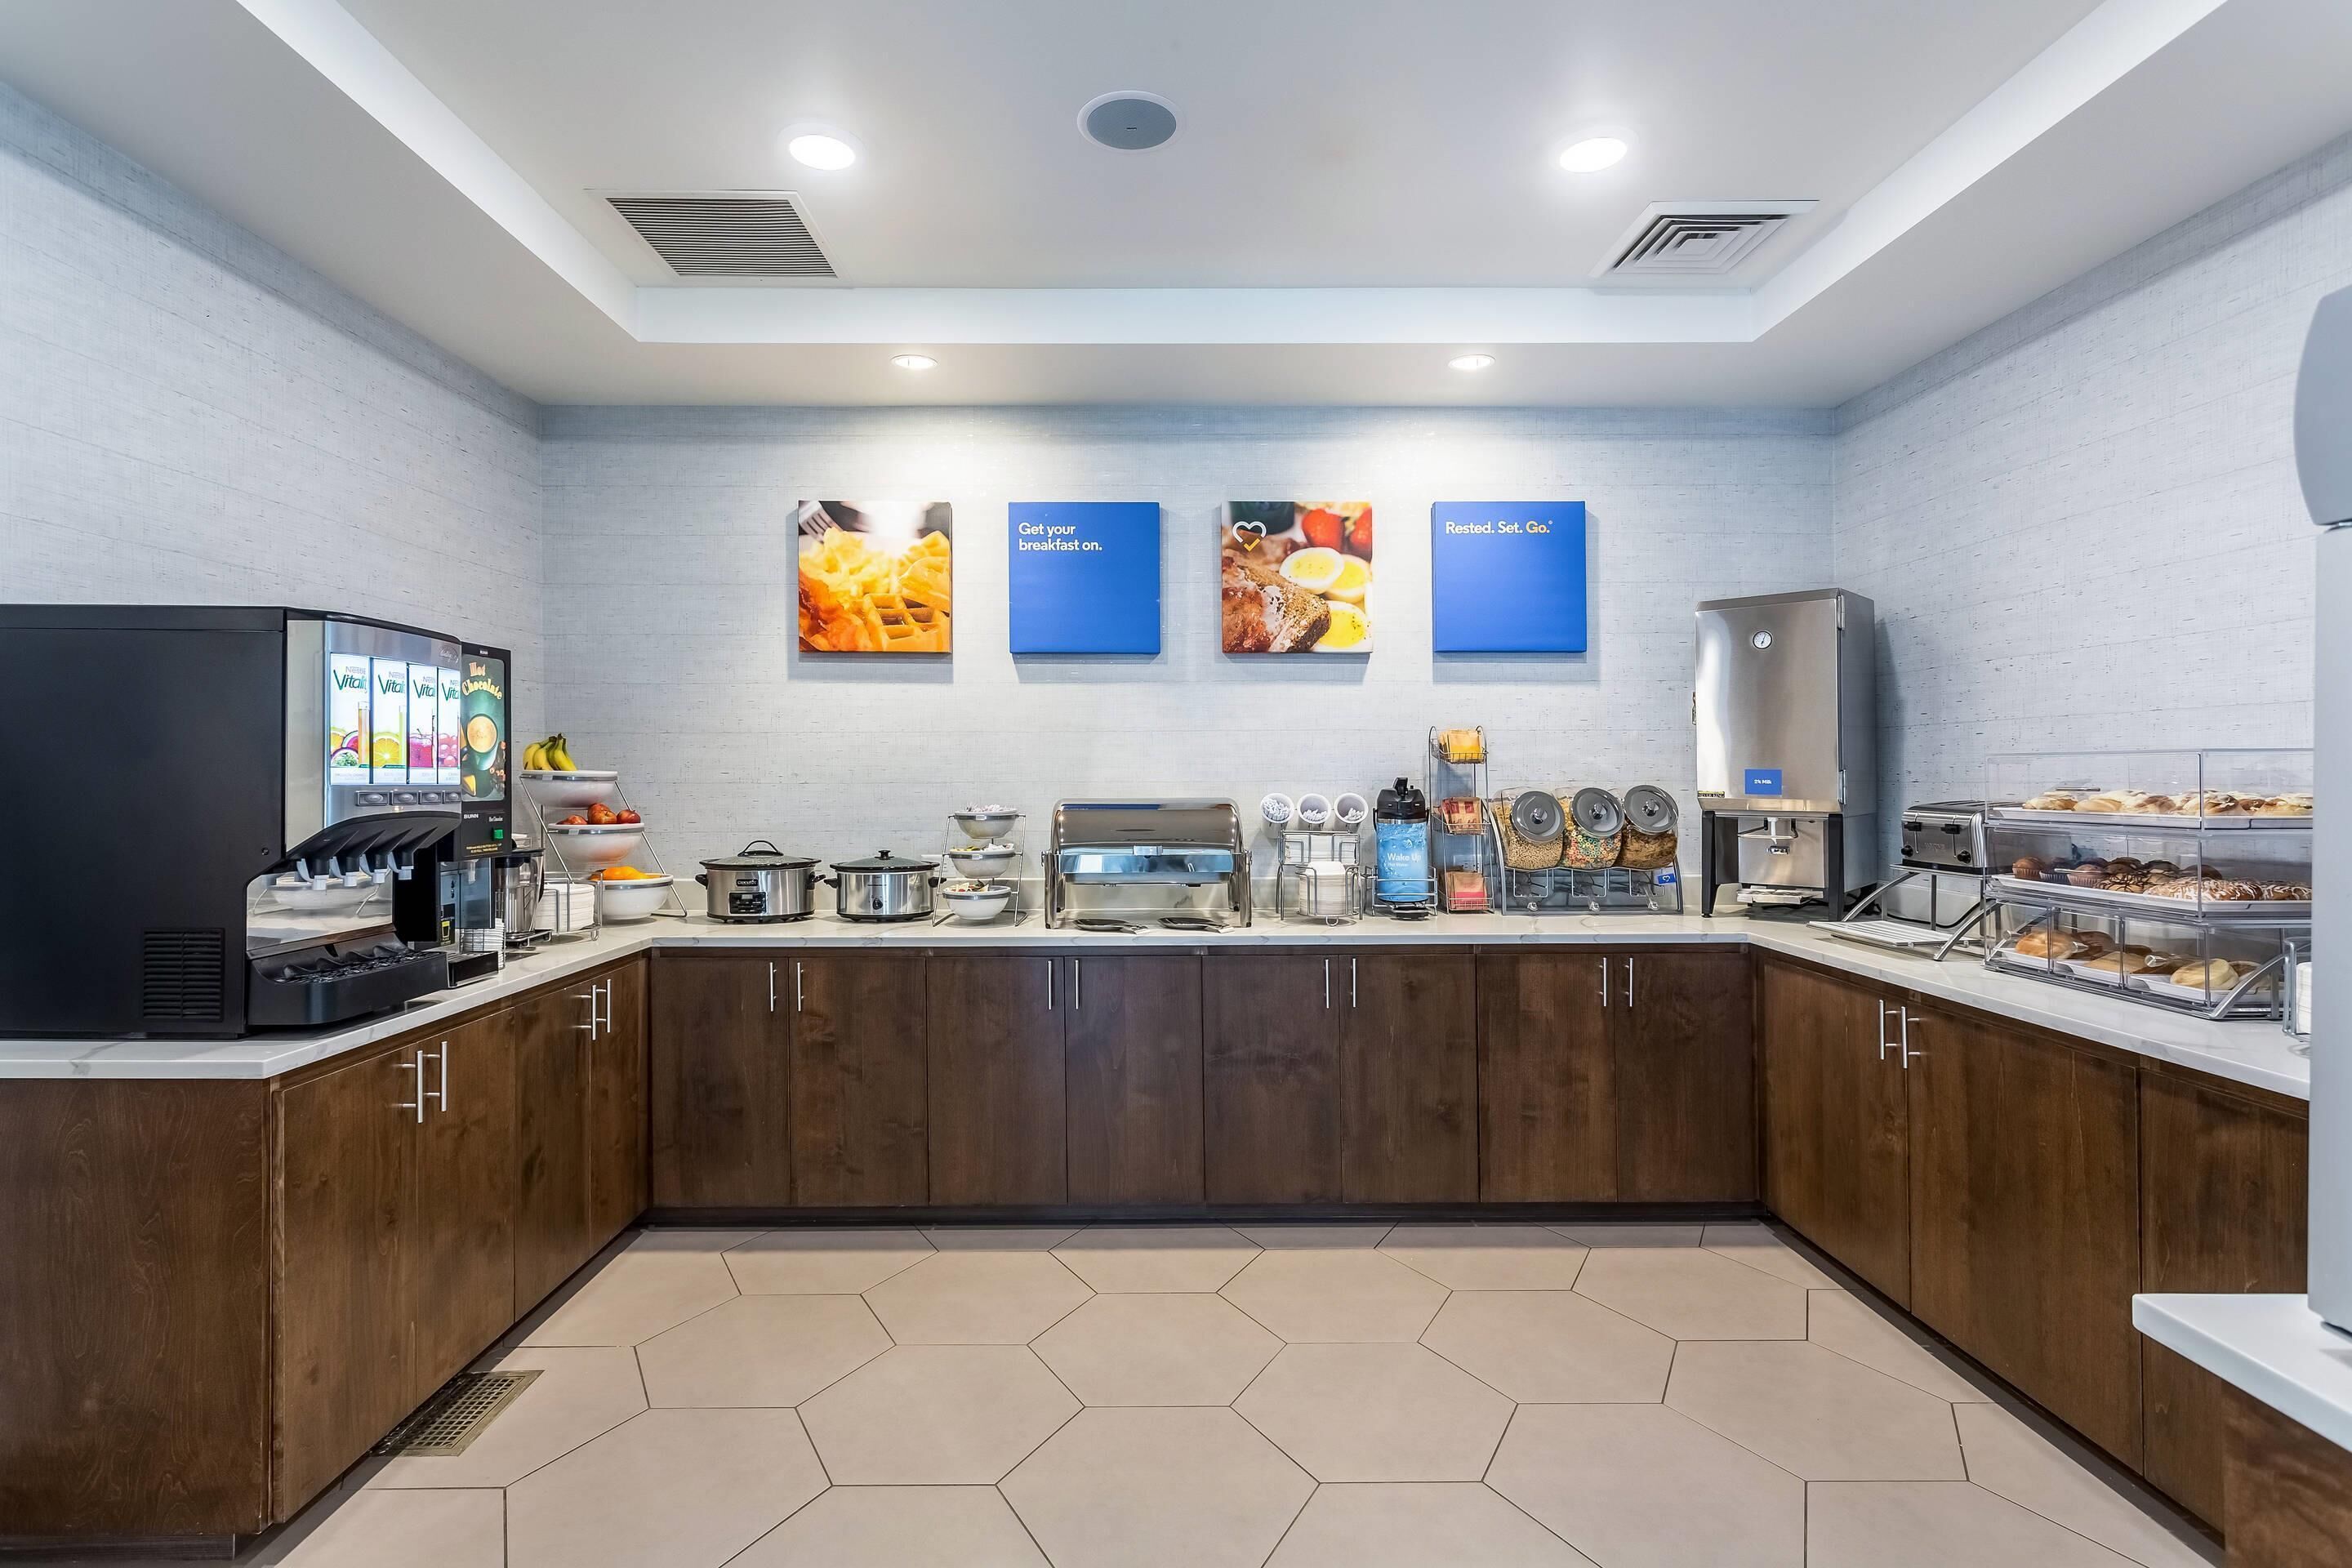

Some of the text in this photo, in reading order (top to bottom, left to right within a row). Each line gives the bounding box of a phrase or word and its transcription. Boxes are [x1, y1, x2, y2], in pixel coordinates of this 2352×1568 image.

[1018, 522, 1076, 537] Get your
[1446, 521, 1494, 534] Rested.
[1497, 520, 1523, 533] Set.
[1018, 538, 1102, 550] breakfast on.
[469, 662, 486, 677] Hot
[461, 678, 502, 700] Chocolate
[1388, 853, 1410, 861] Wake
